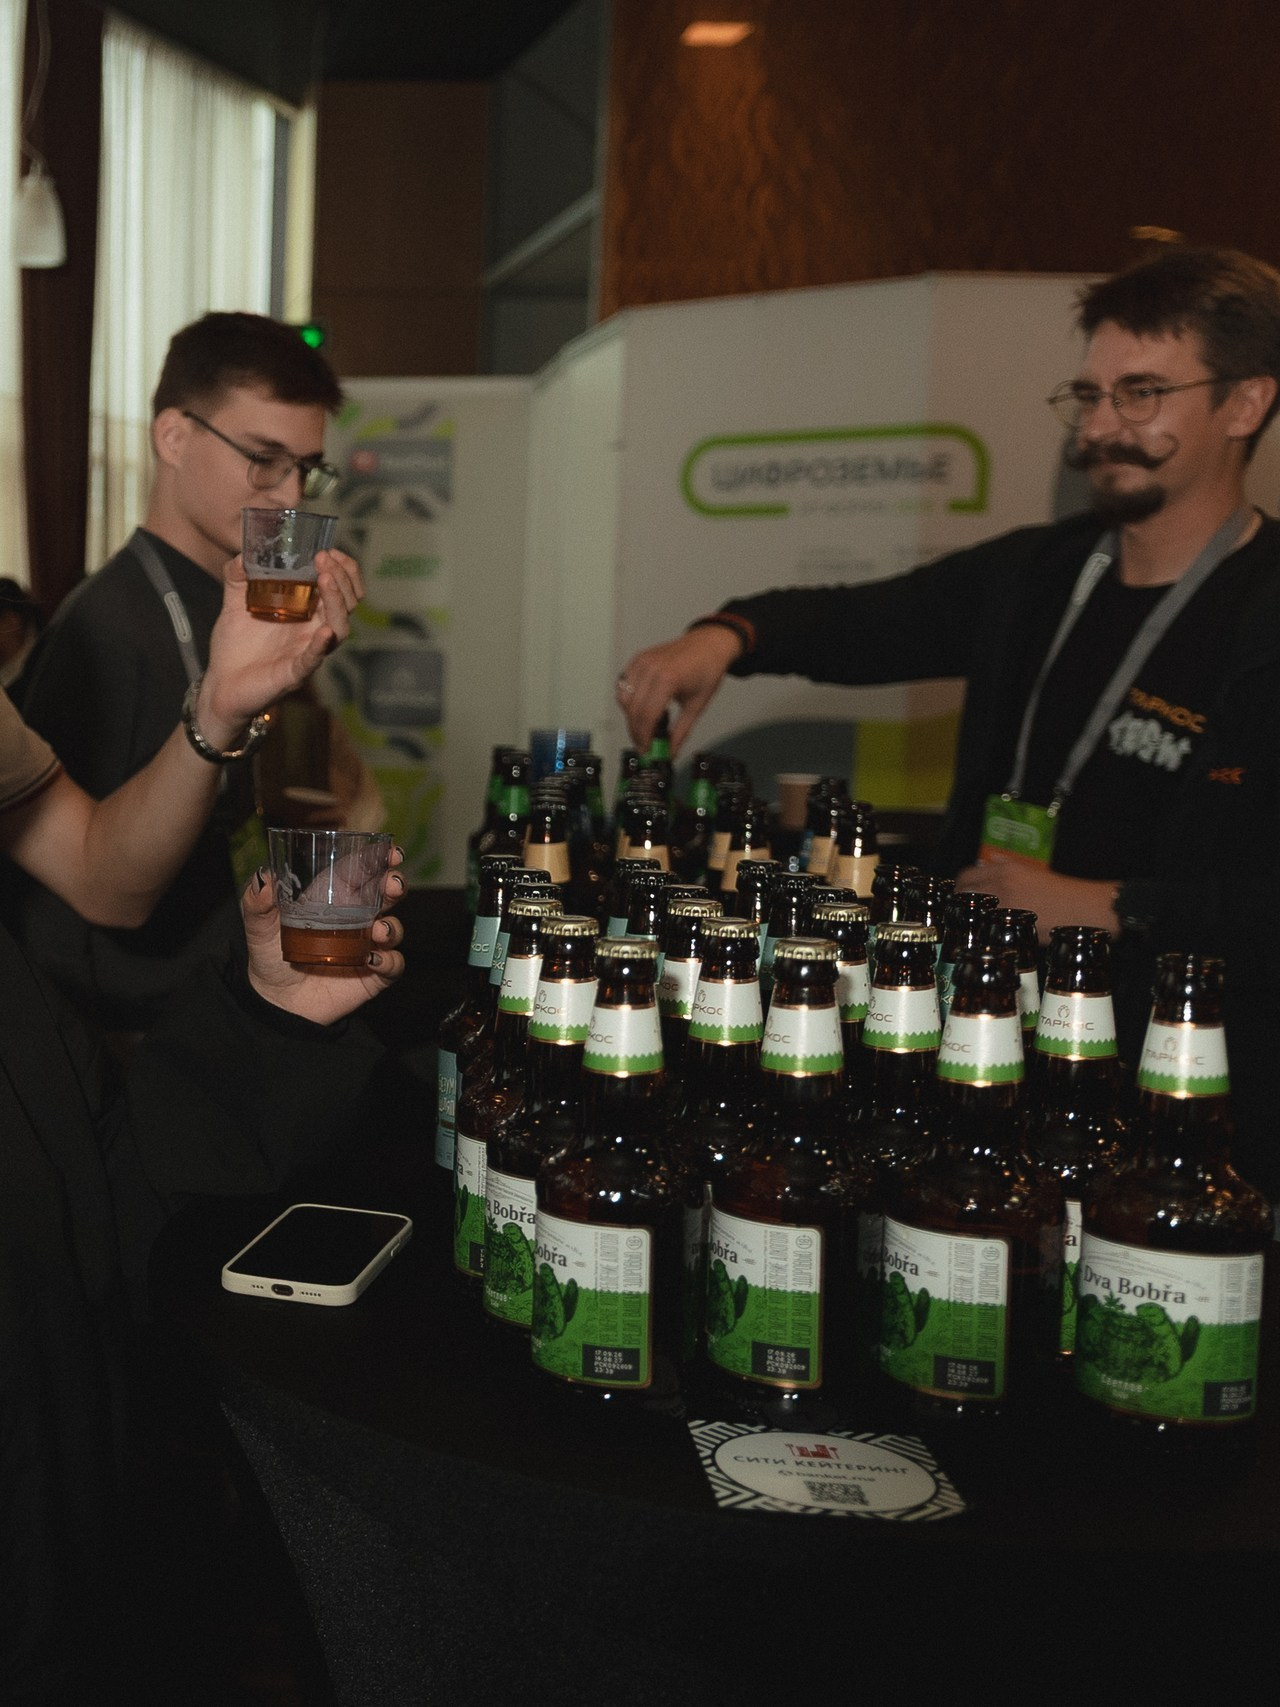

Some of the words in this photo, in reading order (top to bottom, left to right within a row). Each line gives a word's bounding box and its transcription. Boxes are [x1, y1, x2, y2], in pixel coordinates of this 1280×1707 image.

[471, 943, 490, 952] КОС
[660, 981, 680, 992] КОС
[693, 1003, 723, 1016] РКОС
[1145, 1048, 1205, 1066] ТАРКС
[493, 1199, 536, 1225] Bobřa
[536, 1242, 568, 1268] obřa
[711, 1239, 738, 1264] obřa
[1083, 1265, 1111, 1290] Dva
[1118, 1277, 1187, 1304] Bobřa
[733, 1454, 786, 1466] СИТИ
[794, 1459, 909, 1475] КЕЙТЕРИНГ
